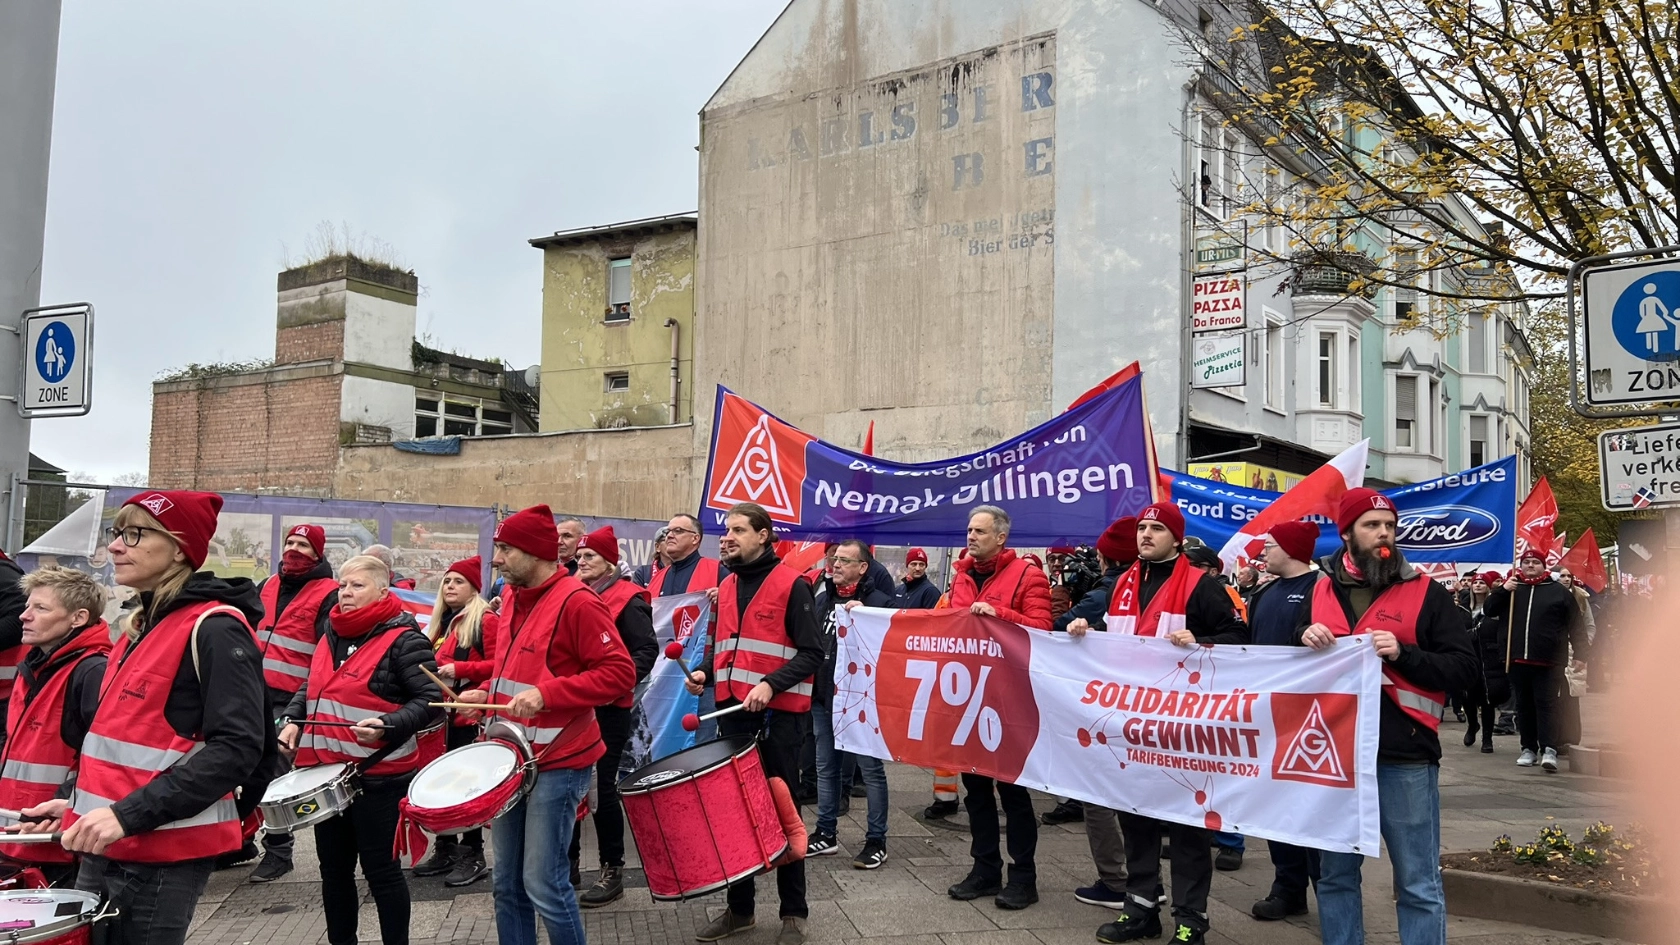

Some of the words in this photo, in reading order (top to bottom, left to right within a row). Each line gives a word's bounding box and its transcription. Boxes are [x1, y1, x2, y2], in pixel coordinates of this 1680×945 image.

[968, 238, 1002, 256] Bier
[1194, 278, 1241, 296] PIZZA
[1193, 318, 1207, 328] Da
[1209, 315, 1242, 326] Franco
[1194, 346, 1242, 368] HEIMSERVICE
[1203, 358, 1243, 380] Pizzeria
[39, 386, 69, 403] ZONE
[814, 479, 945, 515] Nemak
[952, 461, 1134, 504] Dillingen
[1177, 498, 1223, 519] Ford
[1396, 512, 1471, 541] Ford
[905, 635, 978, 655] GEMEINSAM
[980, 637, 1004, 658] FÜR
[905, 659, 1003, 752] 7%
[1080, 680, 1259, 723] SOLIDARITÄT
[1123, 717, 1260, 758] GEWINNT
[1126, 747, 1227, 774] TARIFBEWEGUNG
[1229, 761, 1260, 778] 2024
